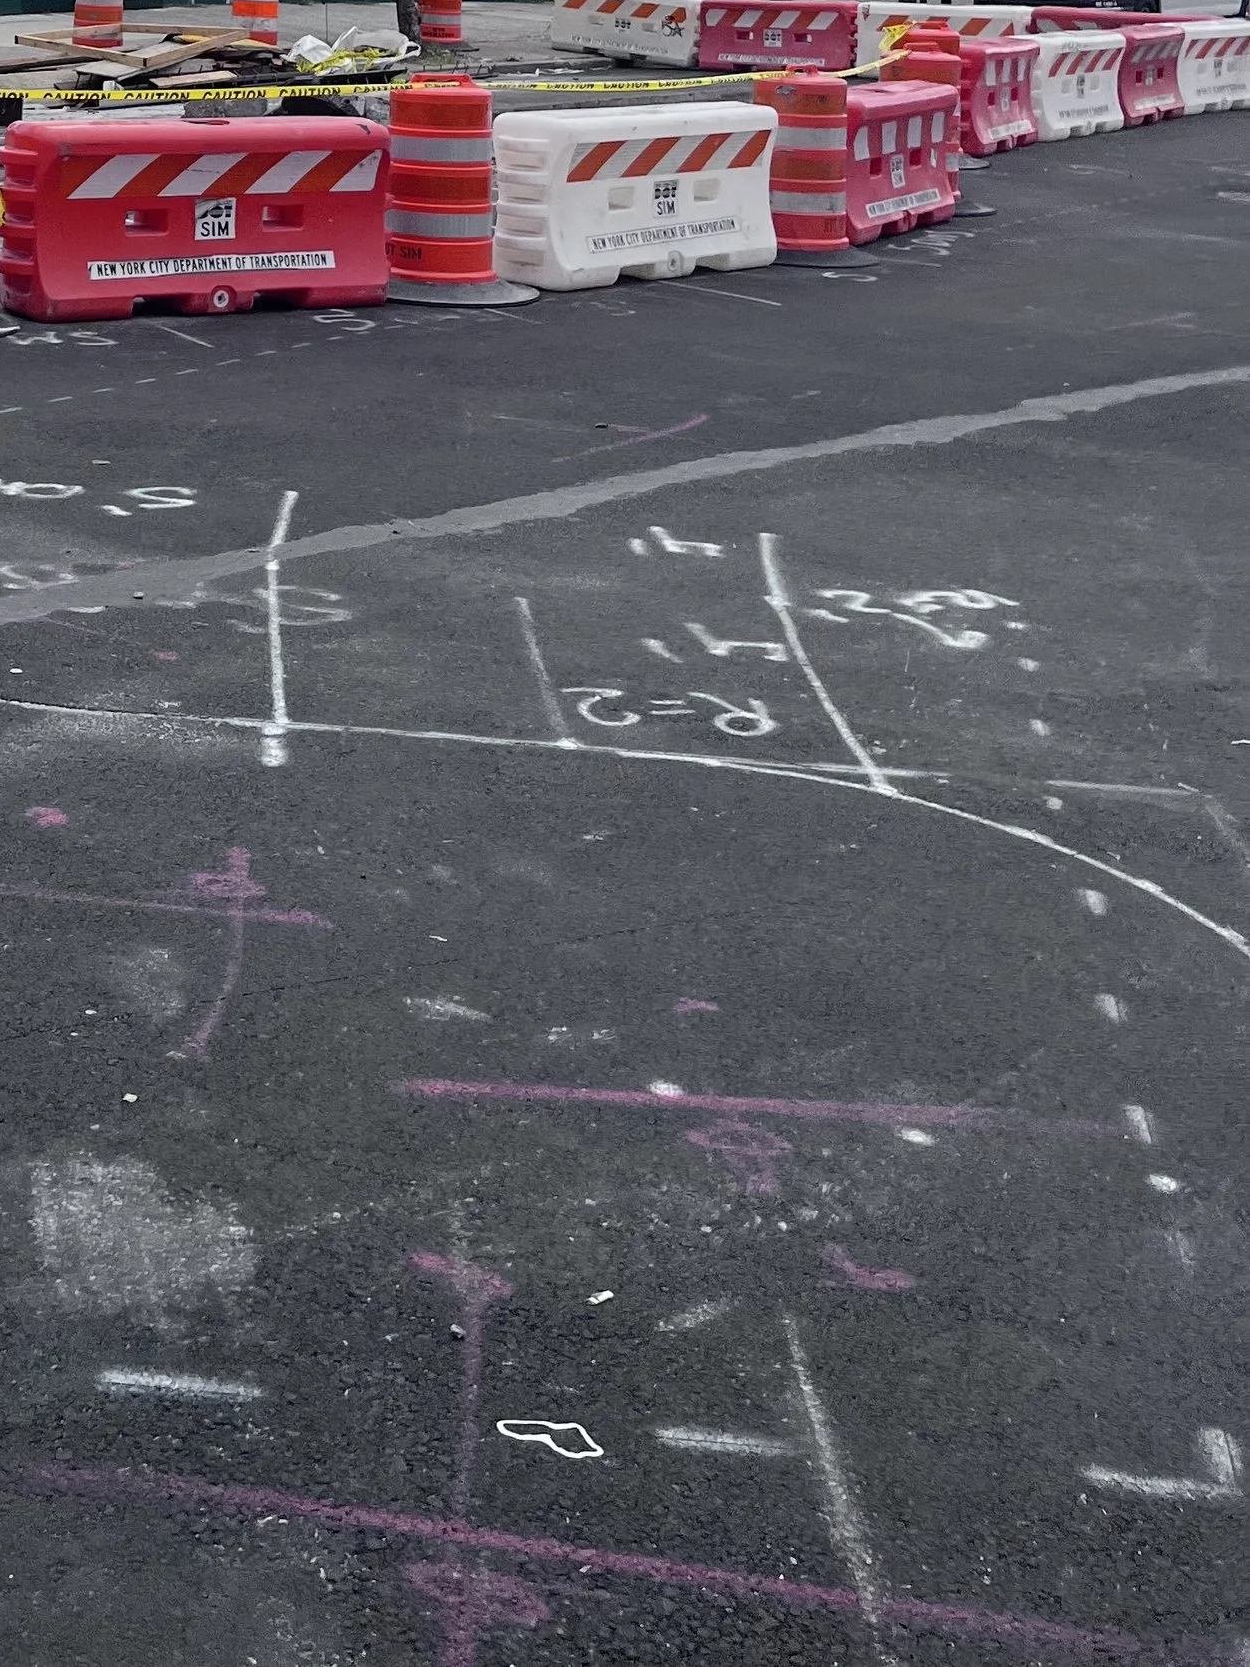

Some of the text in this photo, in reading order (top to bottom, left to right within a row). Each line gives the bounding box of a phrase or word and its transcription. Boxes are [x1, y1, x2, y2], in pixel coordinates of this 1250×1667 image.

[657, 201, 676, 216] SIM
[200, 221, 230, 237] SIM
[608, 234, 625, 248] YORK
[627, 232, 640, 245] CITY
[641, 227, 677, 243] DEPARTMENT
[678, 225, 687, 239] OF
[687, 218, 735, 237] TRANSPORTATION
[97, 253, 327, 277] NEW YORK CITY DEPARTMENT OF TRANSPORTATION
